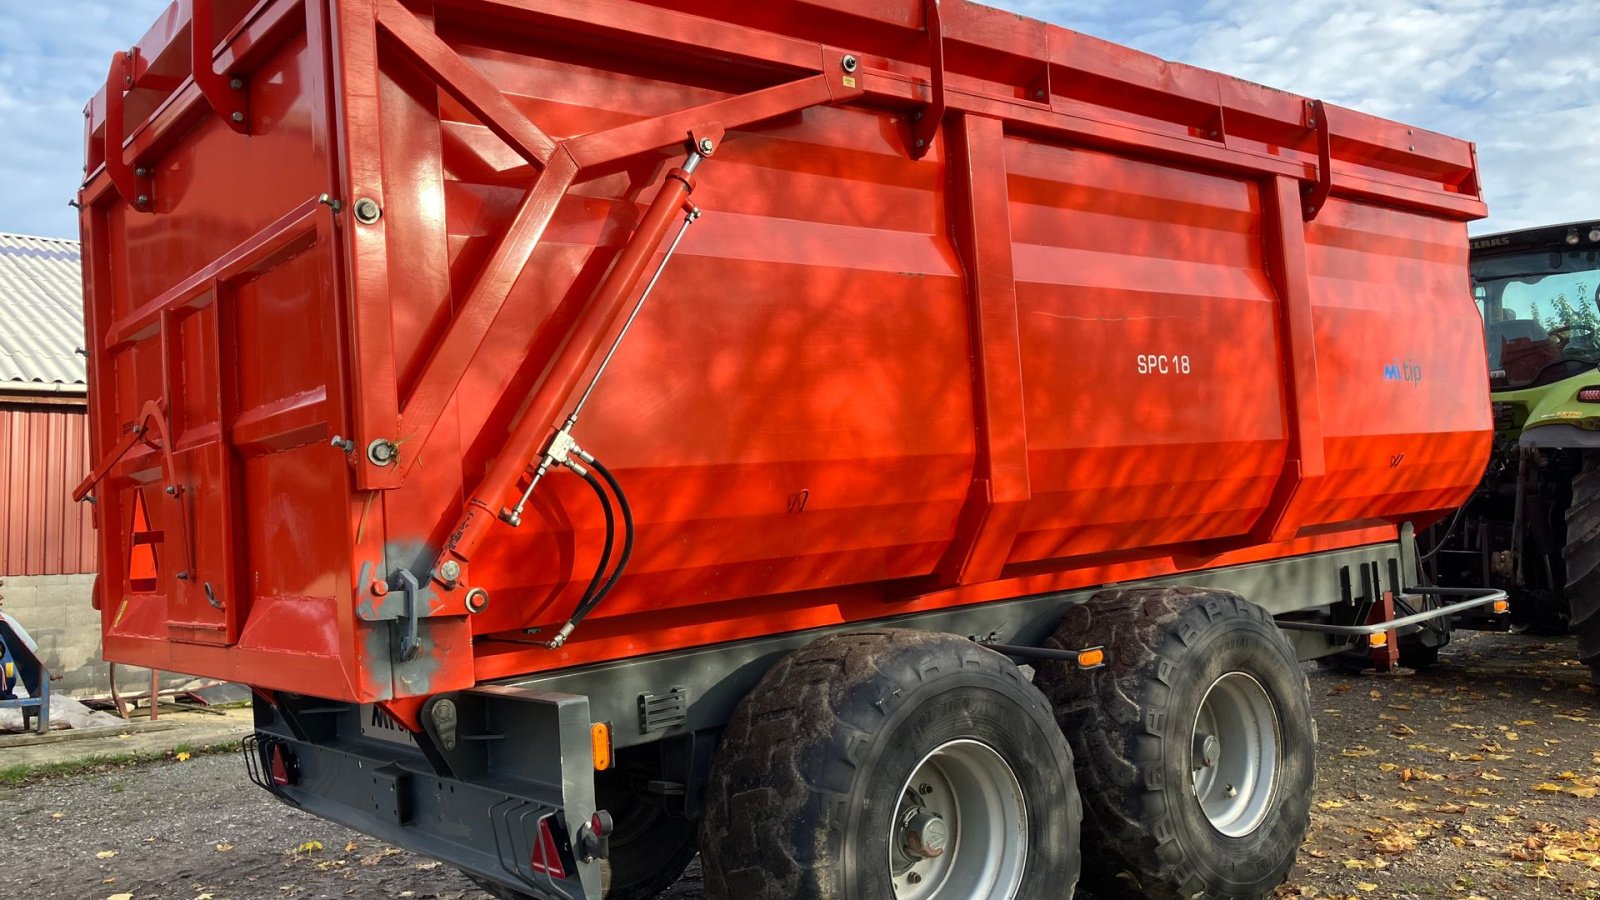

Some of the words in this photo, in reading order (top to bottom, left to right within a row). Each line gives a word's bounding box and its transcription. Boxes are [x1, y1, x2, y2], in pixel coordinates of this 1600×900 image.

[1137, 354, 1169, 375] SPC
[1172, 354, 1191, 375] 18
[1403, 359, 1422, 387] tip
